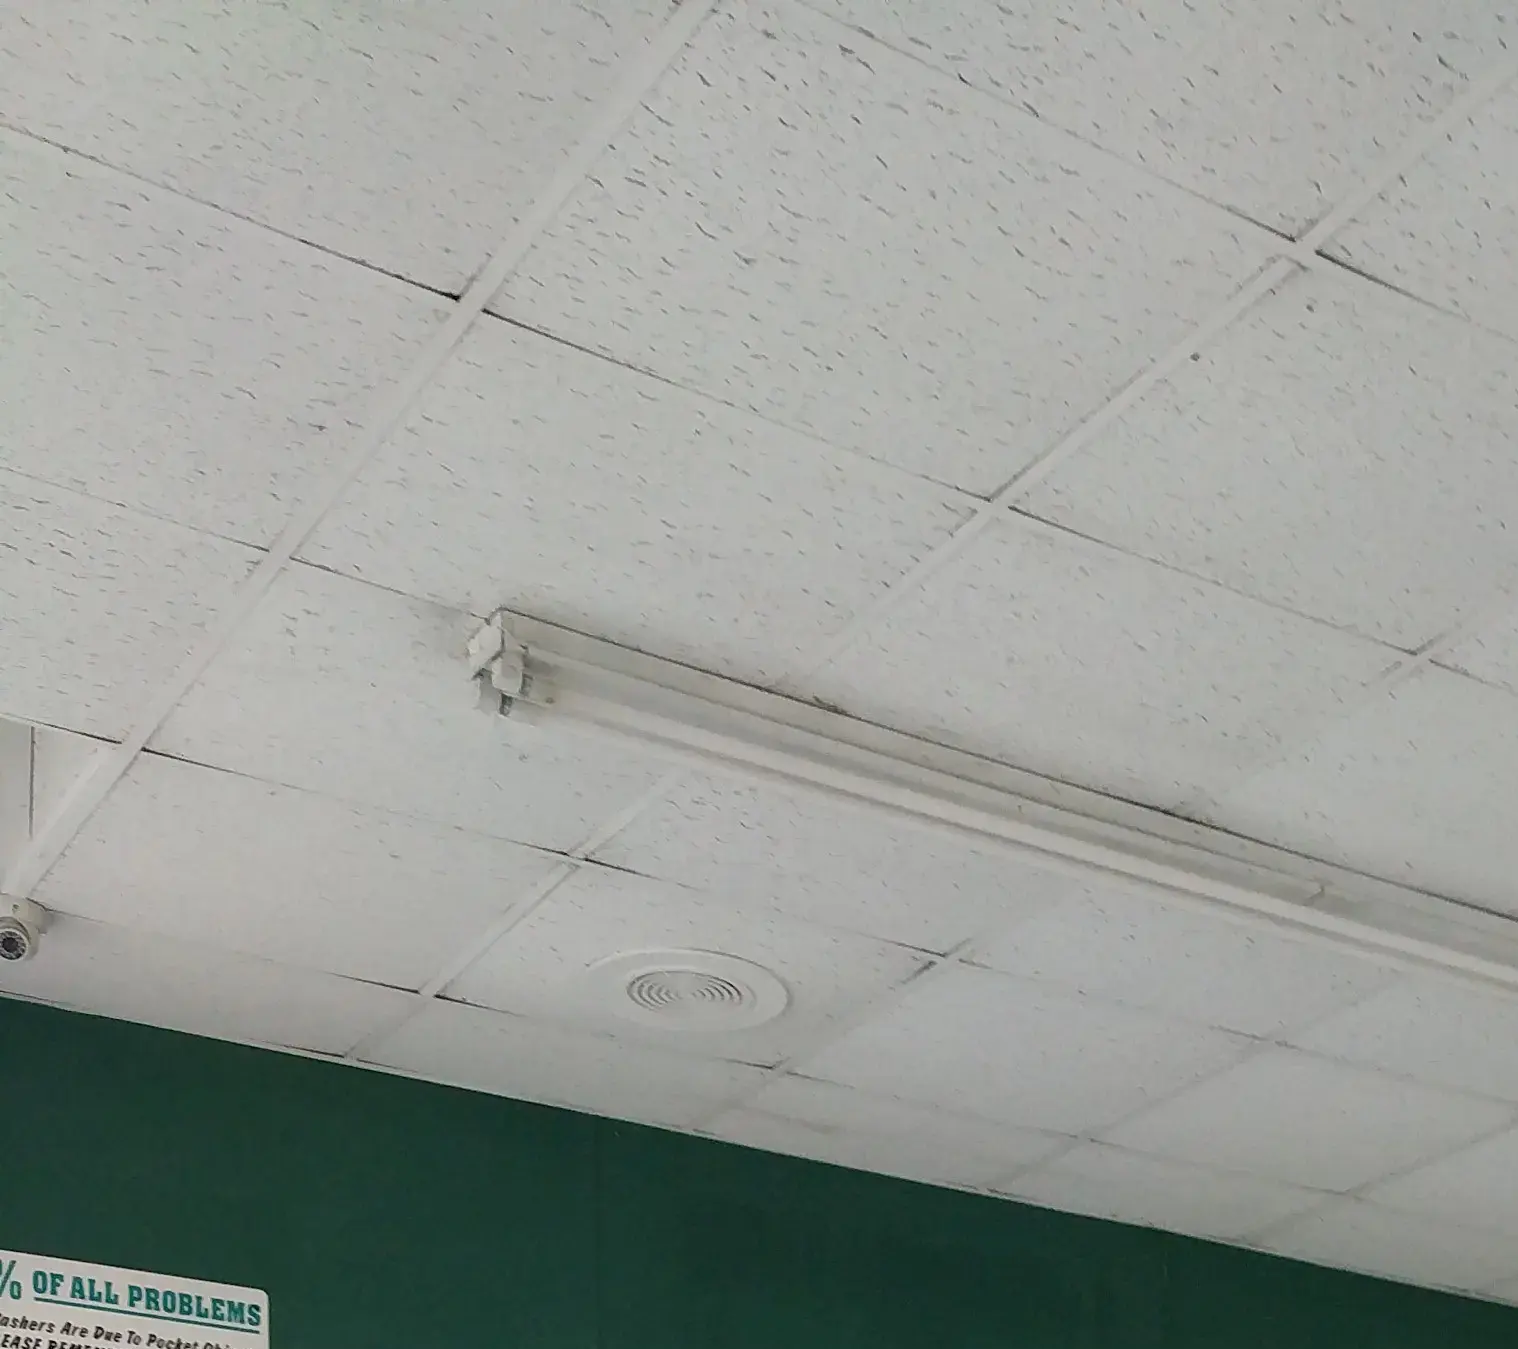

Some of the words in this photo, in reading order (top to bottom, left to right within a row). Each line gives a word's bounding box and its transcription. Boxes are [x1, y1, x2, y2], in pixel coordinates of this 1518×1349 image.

[33, 1270, 65, 1296] OF
[71, 1276, 119, 1305] ALL
[128, 1284, 261, 1327] PROBLEMS
[0, 1313, 55, 1334] ashers
[60, 1322, 88, 1339] Are
[94, 1326, 123, 1344] Due
[127, 1331, 141, 1346] To
